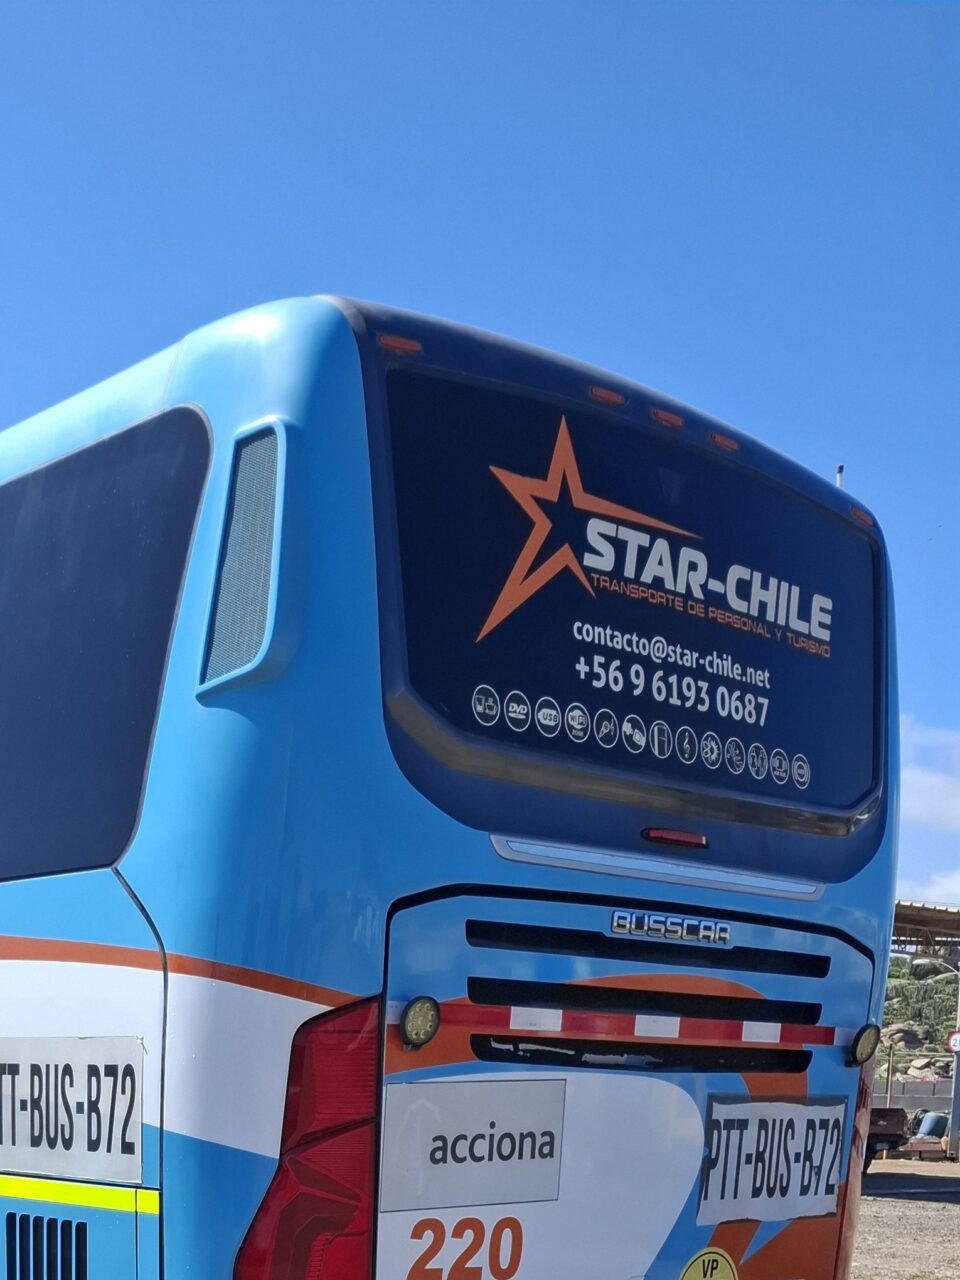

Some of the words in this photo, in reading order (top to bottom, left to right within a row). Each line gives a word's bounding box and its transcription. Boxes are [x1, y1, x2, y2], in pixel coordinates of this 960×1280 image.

[583, 517, 833, 641] STAR-CHILE
[591, 573, 684, 611] TRANSPORTE
[687, 602, 705, 617] DE
[709, 607, 771, 638] PERSONAL
[774, 627, 782, 641] Y
[786, 632, 831, 658] TURISMO
[573, 621, 771, 689] contacto@star-chile.net
[508, 702, 528, 714] DVD
[542, 711, 558, 723] USB
[575, 655, 624, 692] +56
[630, 664, 645, 696] 9
[652, 670, 710, 712] 6193
[716, 686, 769, 727] 0687
[612, 910, 730, 944] BUSSCAR
[429, 1121, 555, 1165] acciona
[703, 1118, 841, 1201] PTT-BUS-B72
[702, 1258, 719, 1279] VP
